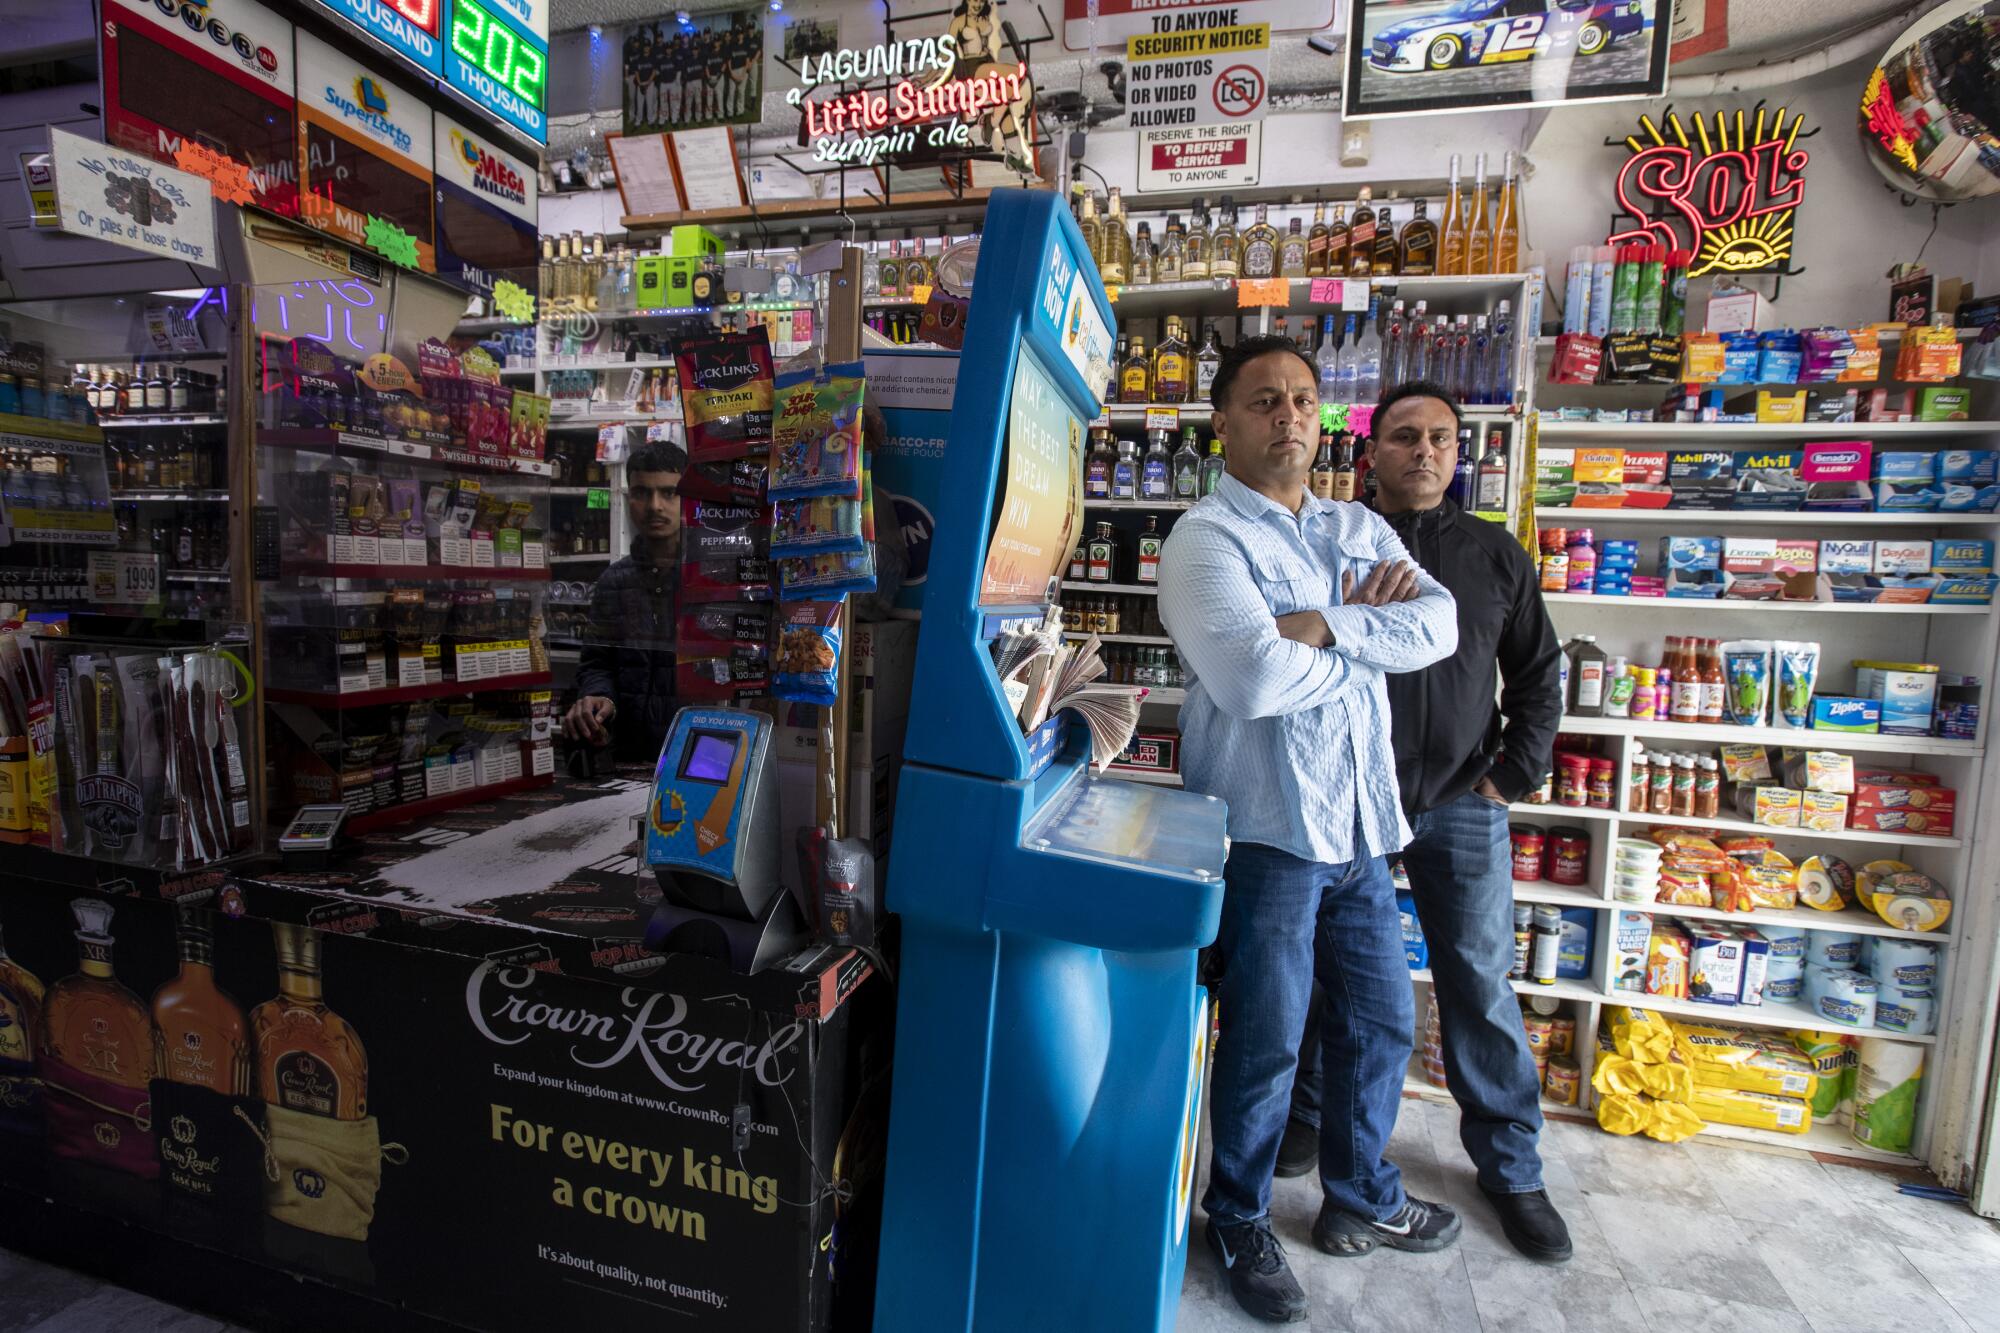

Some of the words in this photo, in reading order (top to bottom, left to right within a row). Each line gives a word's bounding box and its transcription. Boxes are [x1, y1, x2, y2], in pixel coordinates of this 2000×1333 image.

[105, 21, 117, 38] $
[1152, 15, 1171, 33] TO
[1175, 9, 1239, 31] ANYONE
[1135, 35, 1206, 56] SECURITY
[1209, 28, 1263, 49] NOTICE
[1483, 15, 1544, 52] 12
[452, 0, 542, 103] 202
[801, 34, 957, 86] LAGUNITAS
[1131, 65, 1151, 82] NO
[1155, 59, 1213, 80] PHOTOS
[458, 60, 541, 130] THOUSAND
[1131, 88, 1151, 105] OR
[1154, 83, 1197, 104] VIDEO
[324, 86, 412, 146] SuperLotto
[786, 88, 801, 106] a
[805, 89, 889, 137] Little
[1130, 107, 1196, 128] ALLOWED
[927, 116, 970, 148] ale
[1147, 128, 1192, 141] RESERVE
[1198, 127, 1217, 137] THE
[1221, 124, 1252, 137] RIGHT
[1165, 145, 1182, 156] TO
[1185, 140, 1234, 154] REFUSE
[1175, 153, 1222, 168] SERVICE
[476, 147, 525, 196] MEGA
[1168, 171, 1182, 183] TO
[1186, 169, 1228, 182] ANYONE
[108, 156, 151, 178] rolled
[156, 177, 191, 208] coins
[473, 176, 526, 206] MILLIONS
[78, 210, 94, 227] Or
[100, 217, 122, 236] piles
[127, 226, 138, 240] of
[143, 231, 167, 247] loose
[171, 238, 204, 260] change
[1050, 242, 1071, 297] PLAY
[1043, 275, 1065, 330] NOW
[301, 376, 340, 390] EXTRA
[874, 374, 903, 385] product
[903, 376, 935, 385] contains
[882, 385, 915, 395] addictive
[916, 386, 952, 396] chemical.
[1019, 368, 1042, 411] MAY
[705, 391, 753, 407] TERIYAKI
[1819, 402, 1843, 410] HALLS
[1935, 395, 1962, 404] HALLS
[352, 425, 381, 436] EXTRA
[1018, 412, 1038, 452] THE
[1039, 426, 1061, 467] BEST
[25, 440, 55, 449] GOOD
[441, 449, 478, 465] SWISHER
[479, 454, 509, 468] SWEETS
[1623, 455, 1664, 466] TYLENOL
[1673, 454, 1703, 464] Advil
[1744, 455, 1791, 468] Advil
[1813, 453, 1856, 464] Benadryl
[1015, 457, 1050, 497] DREAM
[1816, 465, 1854, 473] ALLERGY
[693, 507, 723, 520] JACK
[1007, 499, 1030, 530] WIN
[22, 532, 57, 541] BACKED
[1825, 542, 1869, 555] NyQuil
[1881, 548, 1926, 558] DayQuil
[1944, 547, 1984, 560] ALEVE
[125, 567, 156, 591] 1999
[1947, 584, 1988, 594] ALEVE
[1828, 701, 1866, 716] Ziploc
[692, 717, 707, 726] DID
[708, 717, 725, 726] YOU
[726, 718, 748, 728] WIN?
[1132, 754, 1157, 762] MAN
[1141, 746, 1157, 754] ED
[699, 833, 716, 847] HERE
[700, 826, 719, 841] CHECK
[84, 945, 108, 961] XR
[590, 946, 622, 968] POP
[1702, 960, 1736, 975] lighter
[1710, 972, 1734, 984] fluid
[466, 958, 617, 1046] Crown
[570, 986, 805, 1092] Royal
[81, 1045, 122, 1074] XR
[282, 1070, 306, 1087] Crown
[299, 1075, 334, 1096] Royal
[493, 1062, 535, 1084] Expand
[538, 1074, 563, 1091] your
[566, 1077, 618, 1103] kingdom
[620, 1092, 634, 1104] at
[162, 1138, 185, 1164] Crown
[180, 1146, 221, 1174] Royal
[490, 1104, 554, 1152] For
[562, 1130, 674, 1188] every
[683, 1146, 779, 1215] king
[552, 1176, 574, 1208] a
[583, 1185, 707, 1242] crown
[538, 1244, 557, 1262] It's
[559, 1246, 594, 1272] about
[596, 1260, 643, 1287] quality,
[645, 1275, 667, 1292] not
